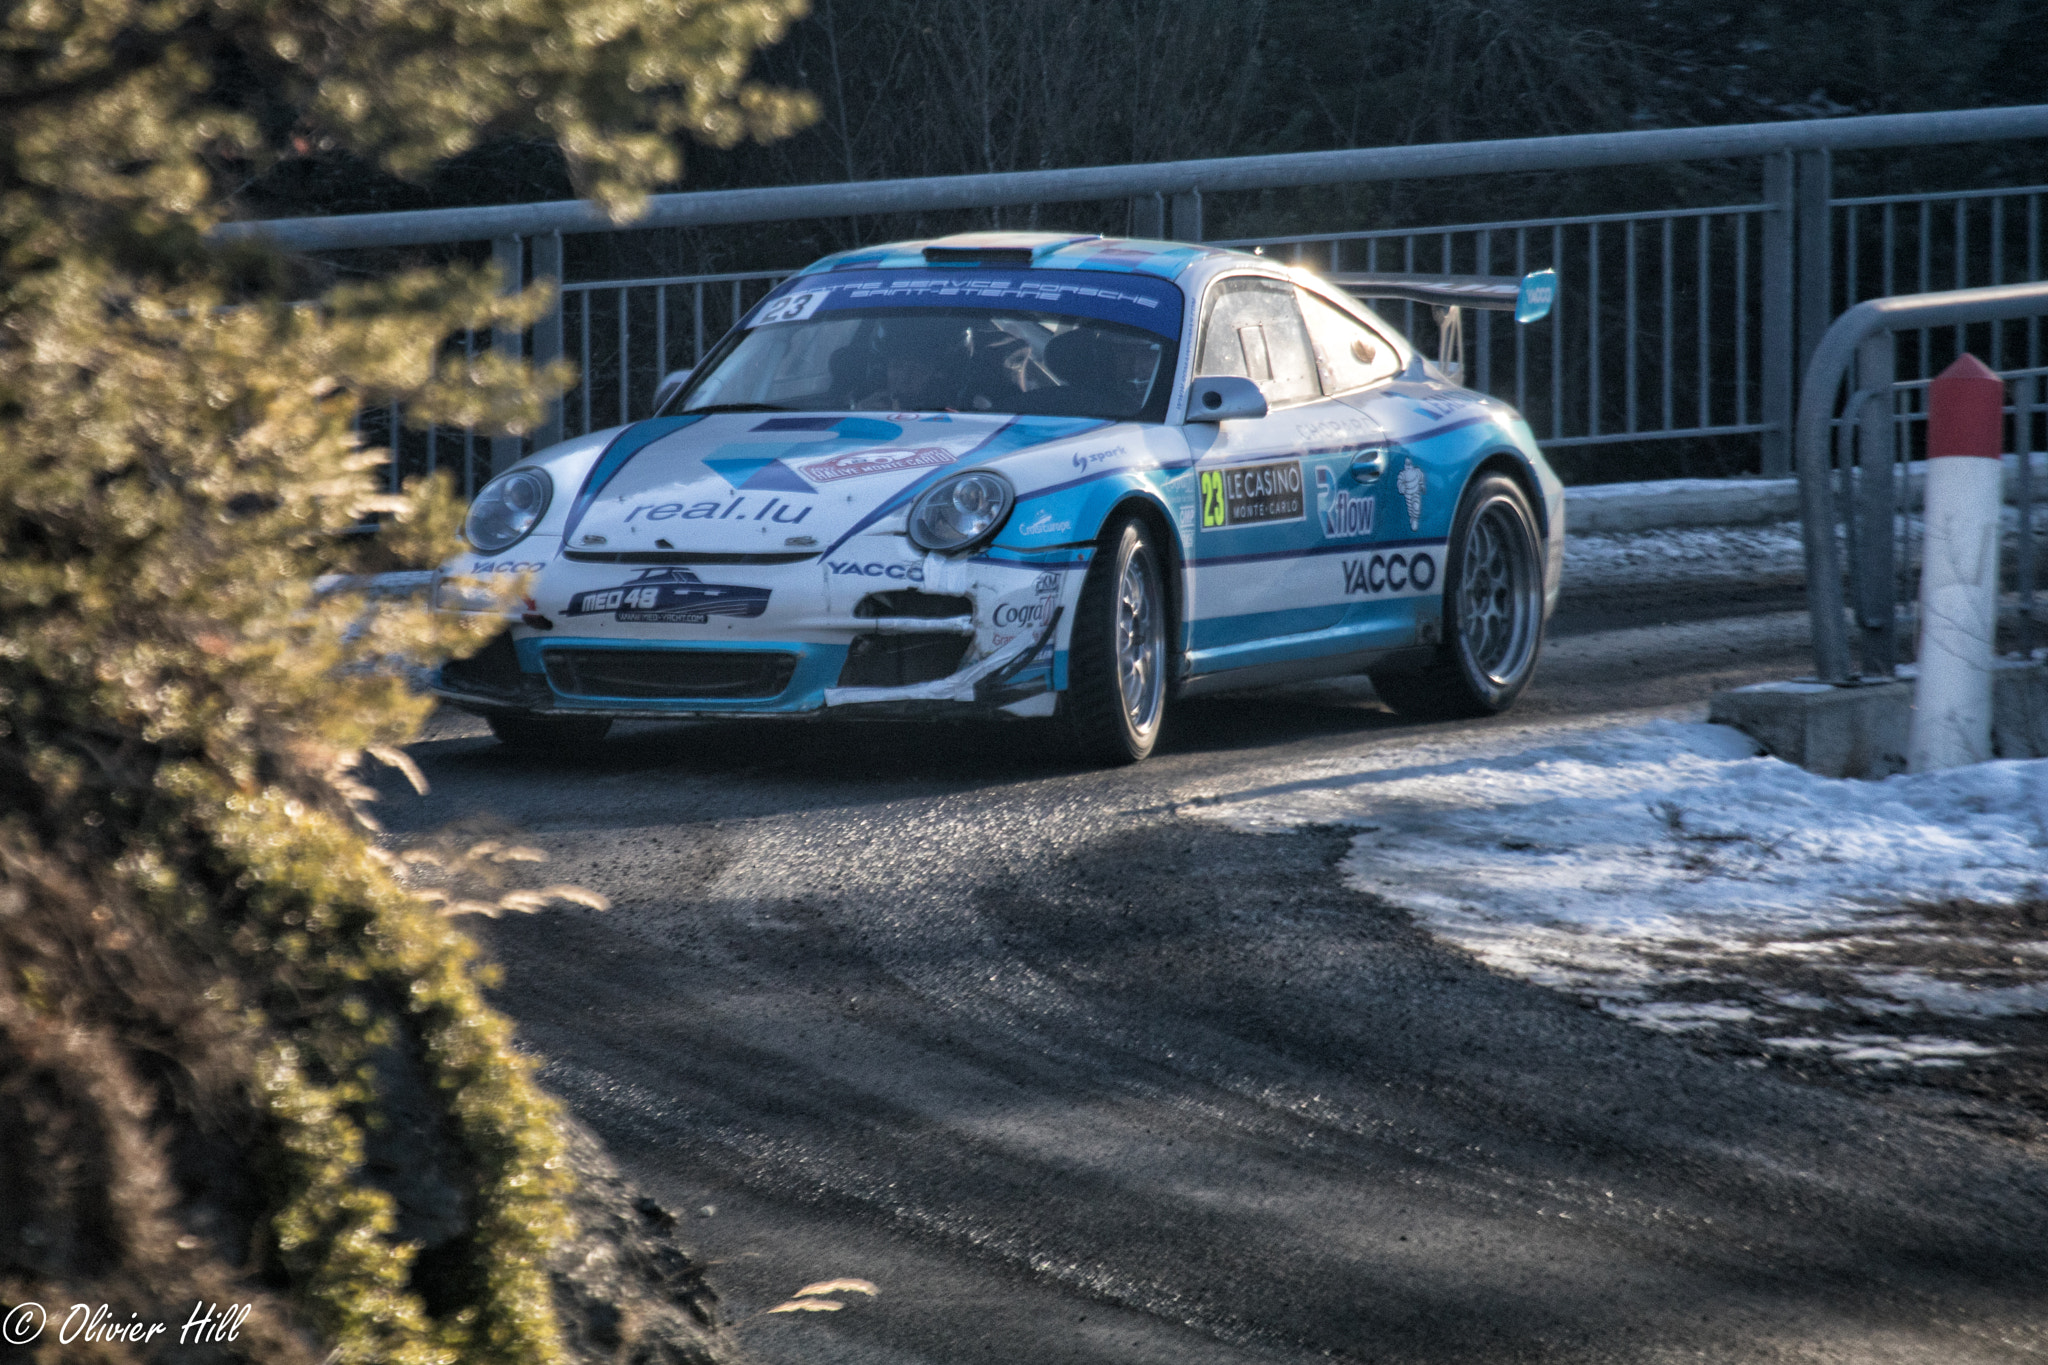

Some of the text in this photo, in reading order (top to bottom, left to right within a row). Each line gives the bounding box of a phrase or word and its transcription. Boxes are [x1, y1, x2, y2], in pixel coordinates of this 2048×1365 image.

[760, 293, 814, 323] 23
[889, 280, 1011, 289] SERVICE
[1019, 282, 1159, 308] PORSCHE
[811, 465, 858, 481] RALLYE
[1227, 474, 1243, 499] LE
[1244, 467, 1300, 498] CASINO
[623, 496, 813, 525] real.lu
[1201, 470, 1225, 527] 23
[470, 561, 546, 574] YACCO
[827, 562, 925, 582] YACCO
[1341, 552, 1436, 595] YACCO
[624, 587, 659, 609] 48
